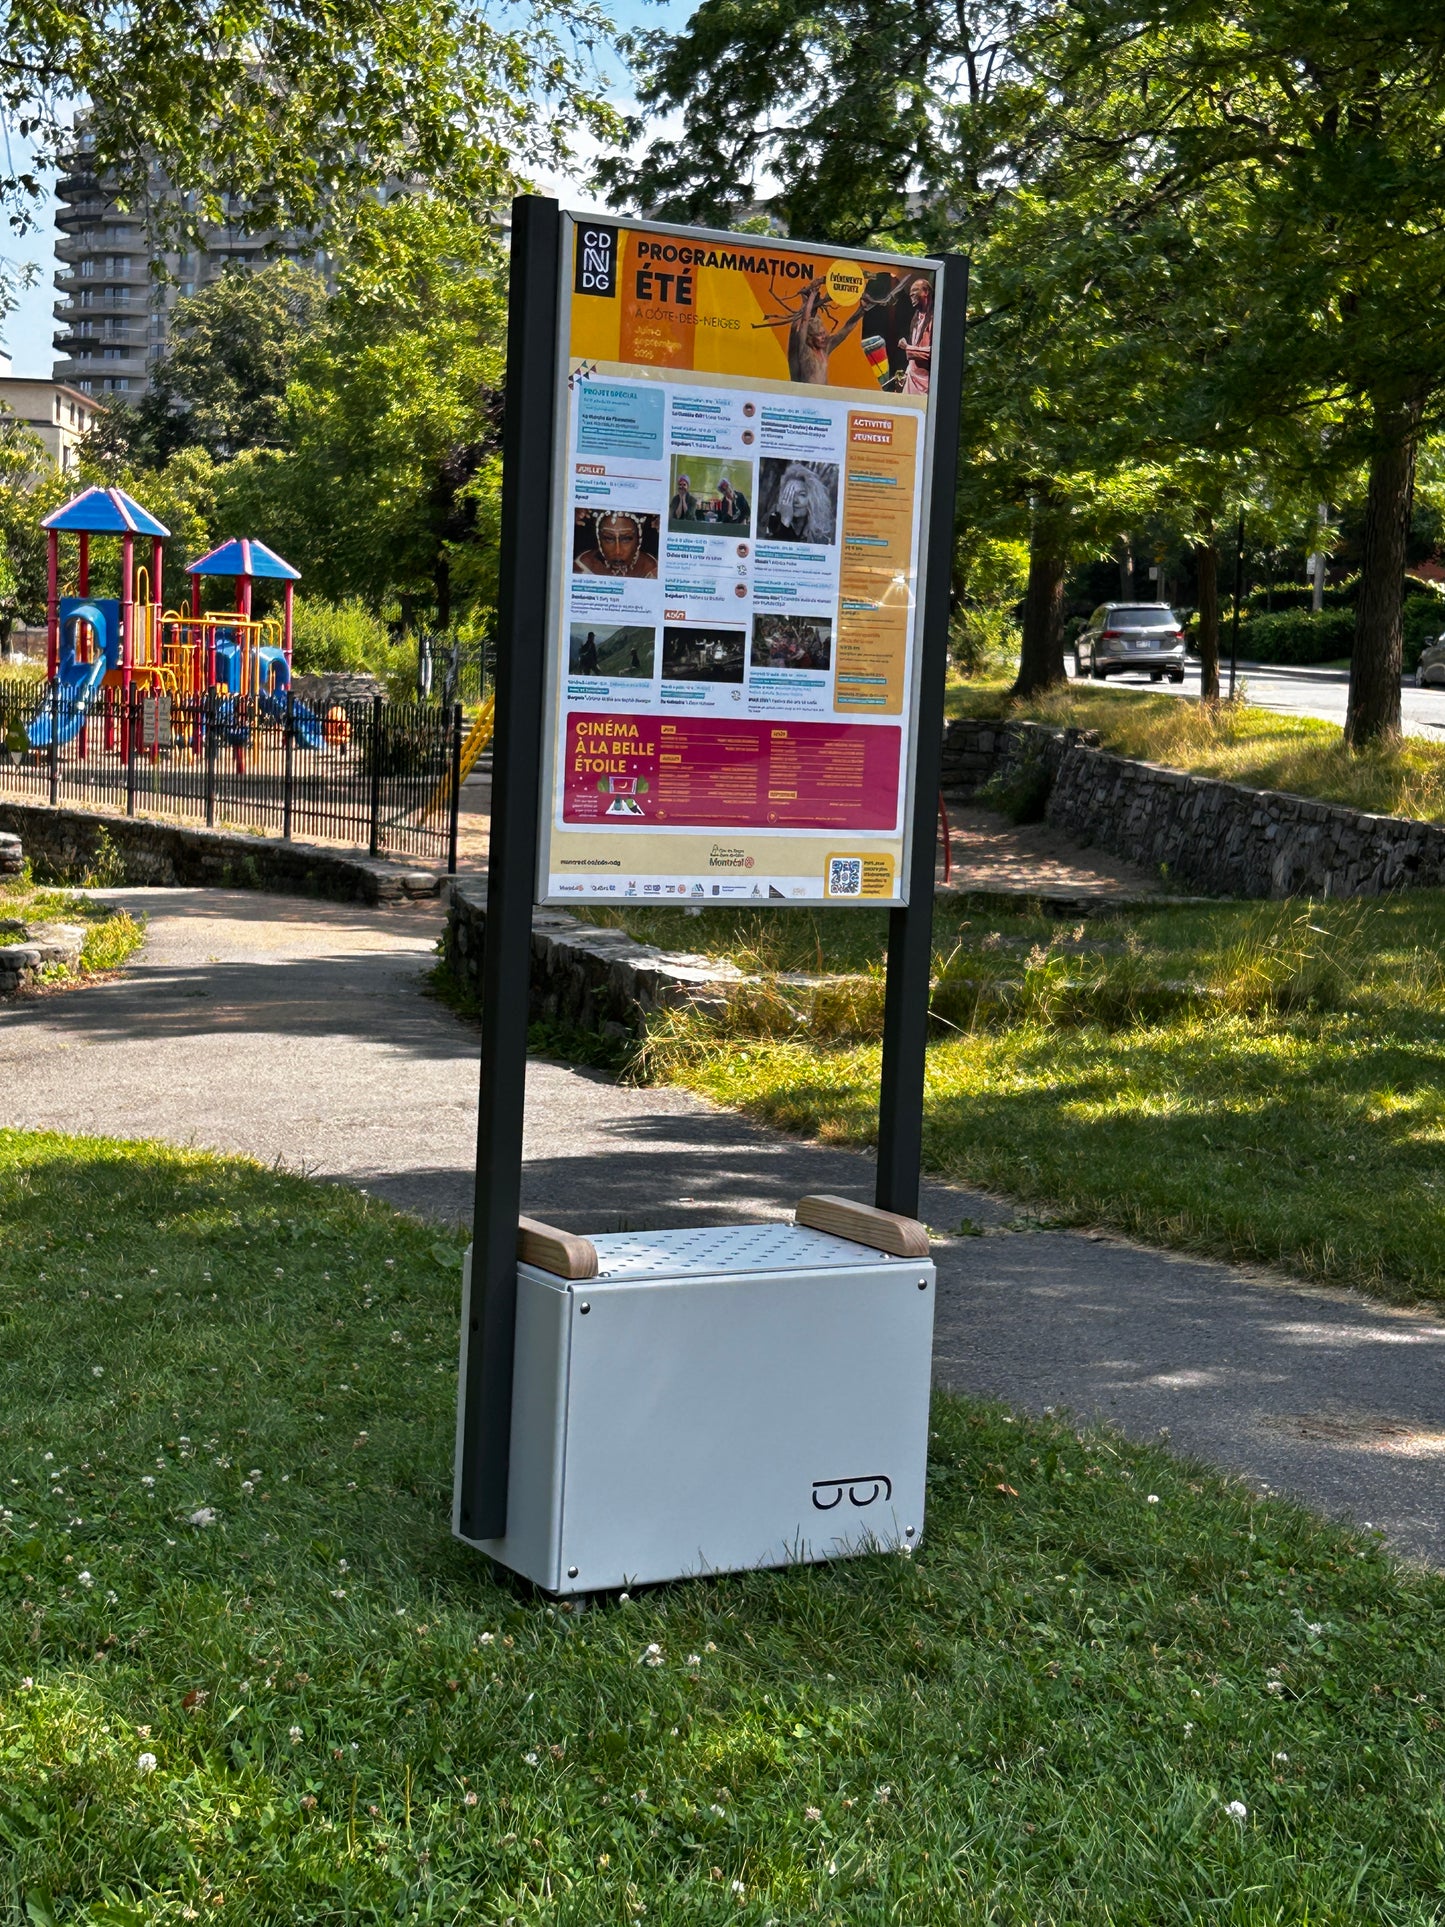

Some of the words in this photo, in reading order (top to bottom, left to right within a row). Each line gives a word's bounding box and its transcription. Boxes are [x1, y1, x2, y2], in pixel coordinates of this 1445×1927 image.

[583, 230, 611, 248] CD
[637, 241, 814, 280] PROGRAMMATION
[582, 272, 610, 290] DG
[636, 262, 692, 306] ÉTÉ
[853, 432, 890, 443] JEUNESSE
[575, 719, 640, 738] CINÉMA
[574, 737, 587, 755] À
[589, 740, 609, 756] LA
[612, 742, 655, 757] BELLE
[574, 755, 627, 774] ÉTOILE
